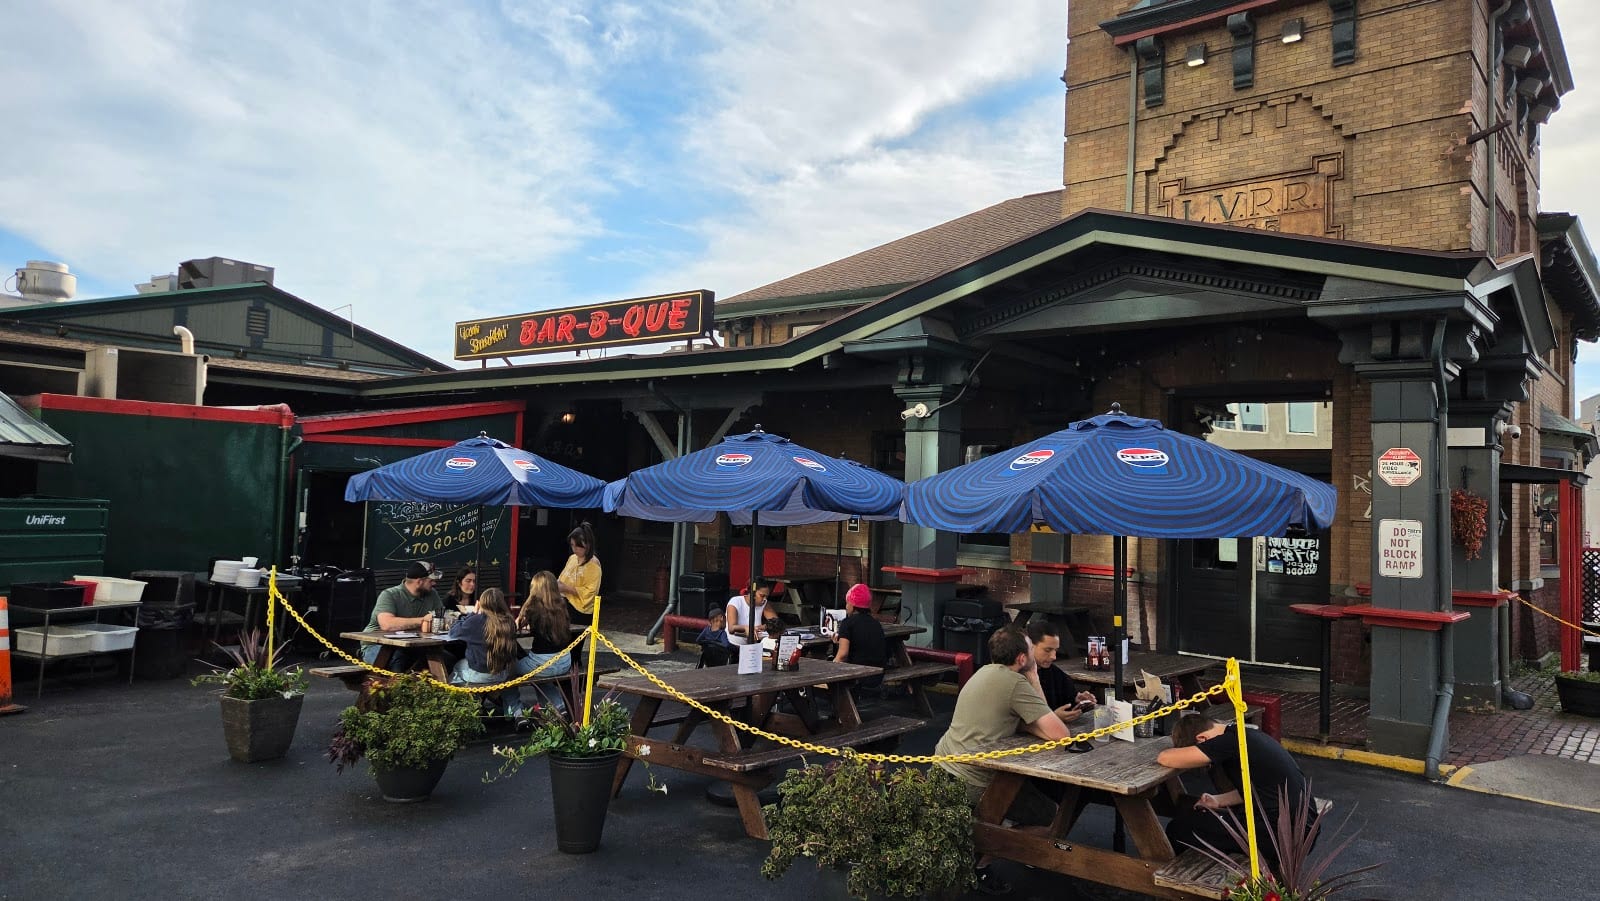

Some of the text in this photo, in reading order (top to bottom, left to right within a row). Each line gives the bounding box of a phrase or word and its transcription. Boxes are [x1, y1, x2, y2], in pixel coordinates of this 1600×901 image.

[519, 298, 692, 346] BAR-B-QUE
[1120, 453, 1165, 462] PEPSI
[25, 514, 66, 525] UniFirst
[412, 519, 452, 537] HOST
[1393, 527, 1407, 537] DO
[411, 528, 475, 555] TO GO-GO
[1390, 538, 1410, 548] NOT
[1383, 549, 1417, 559] BLOCK
[1385, 560, 1416, 570] RAMP
